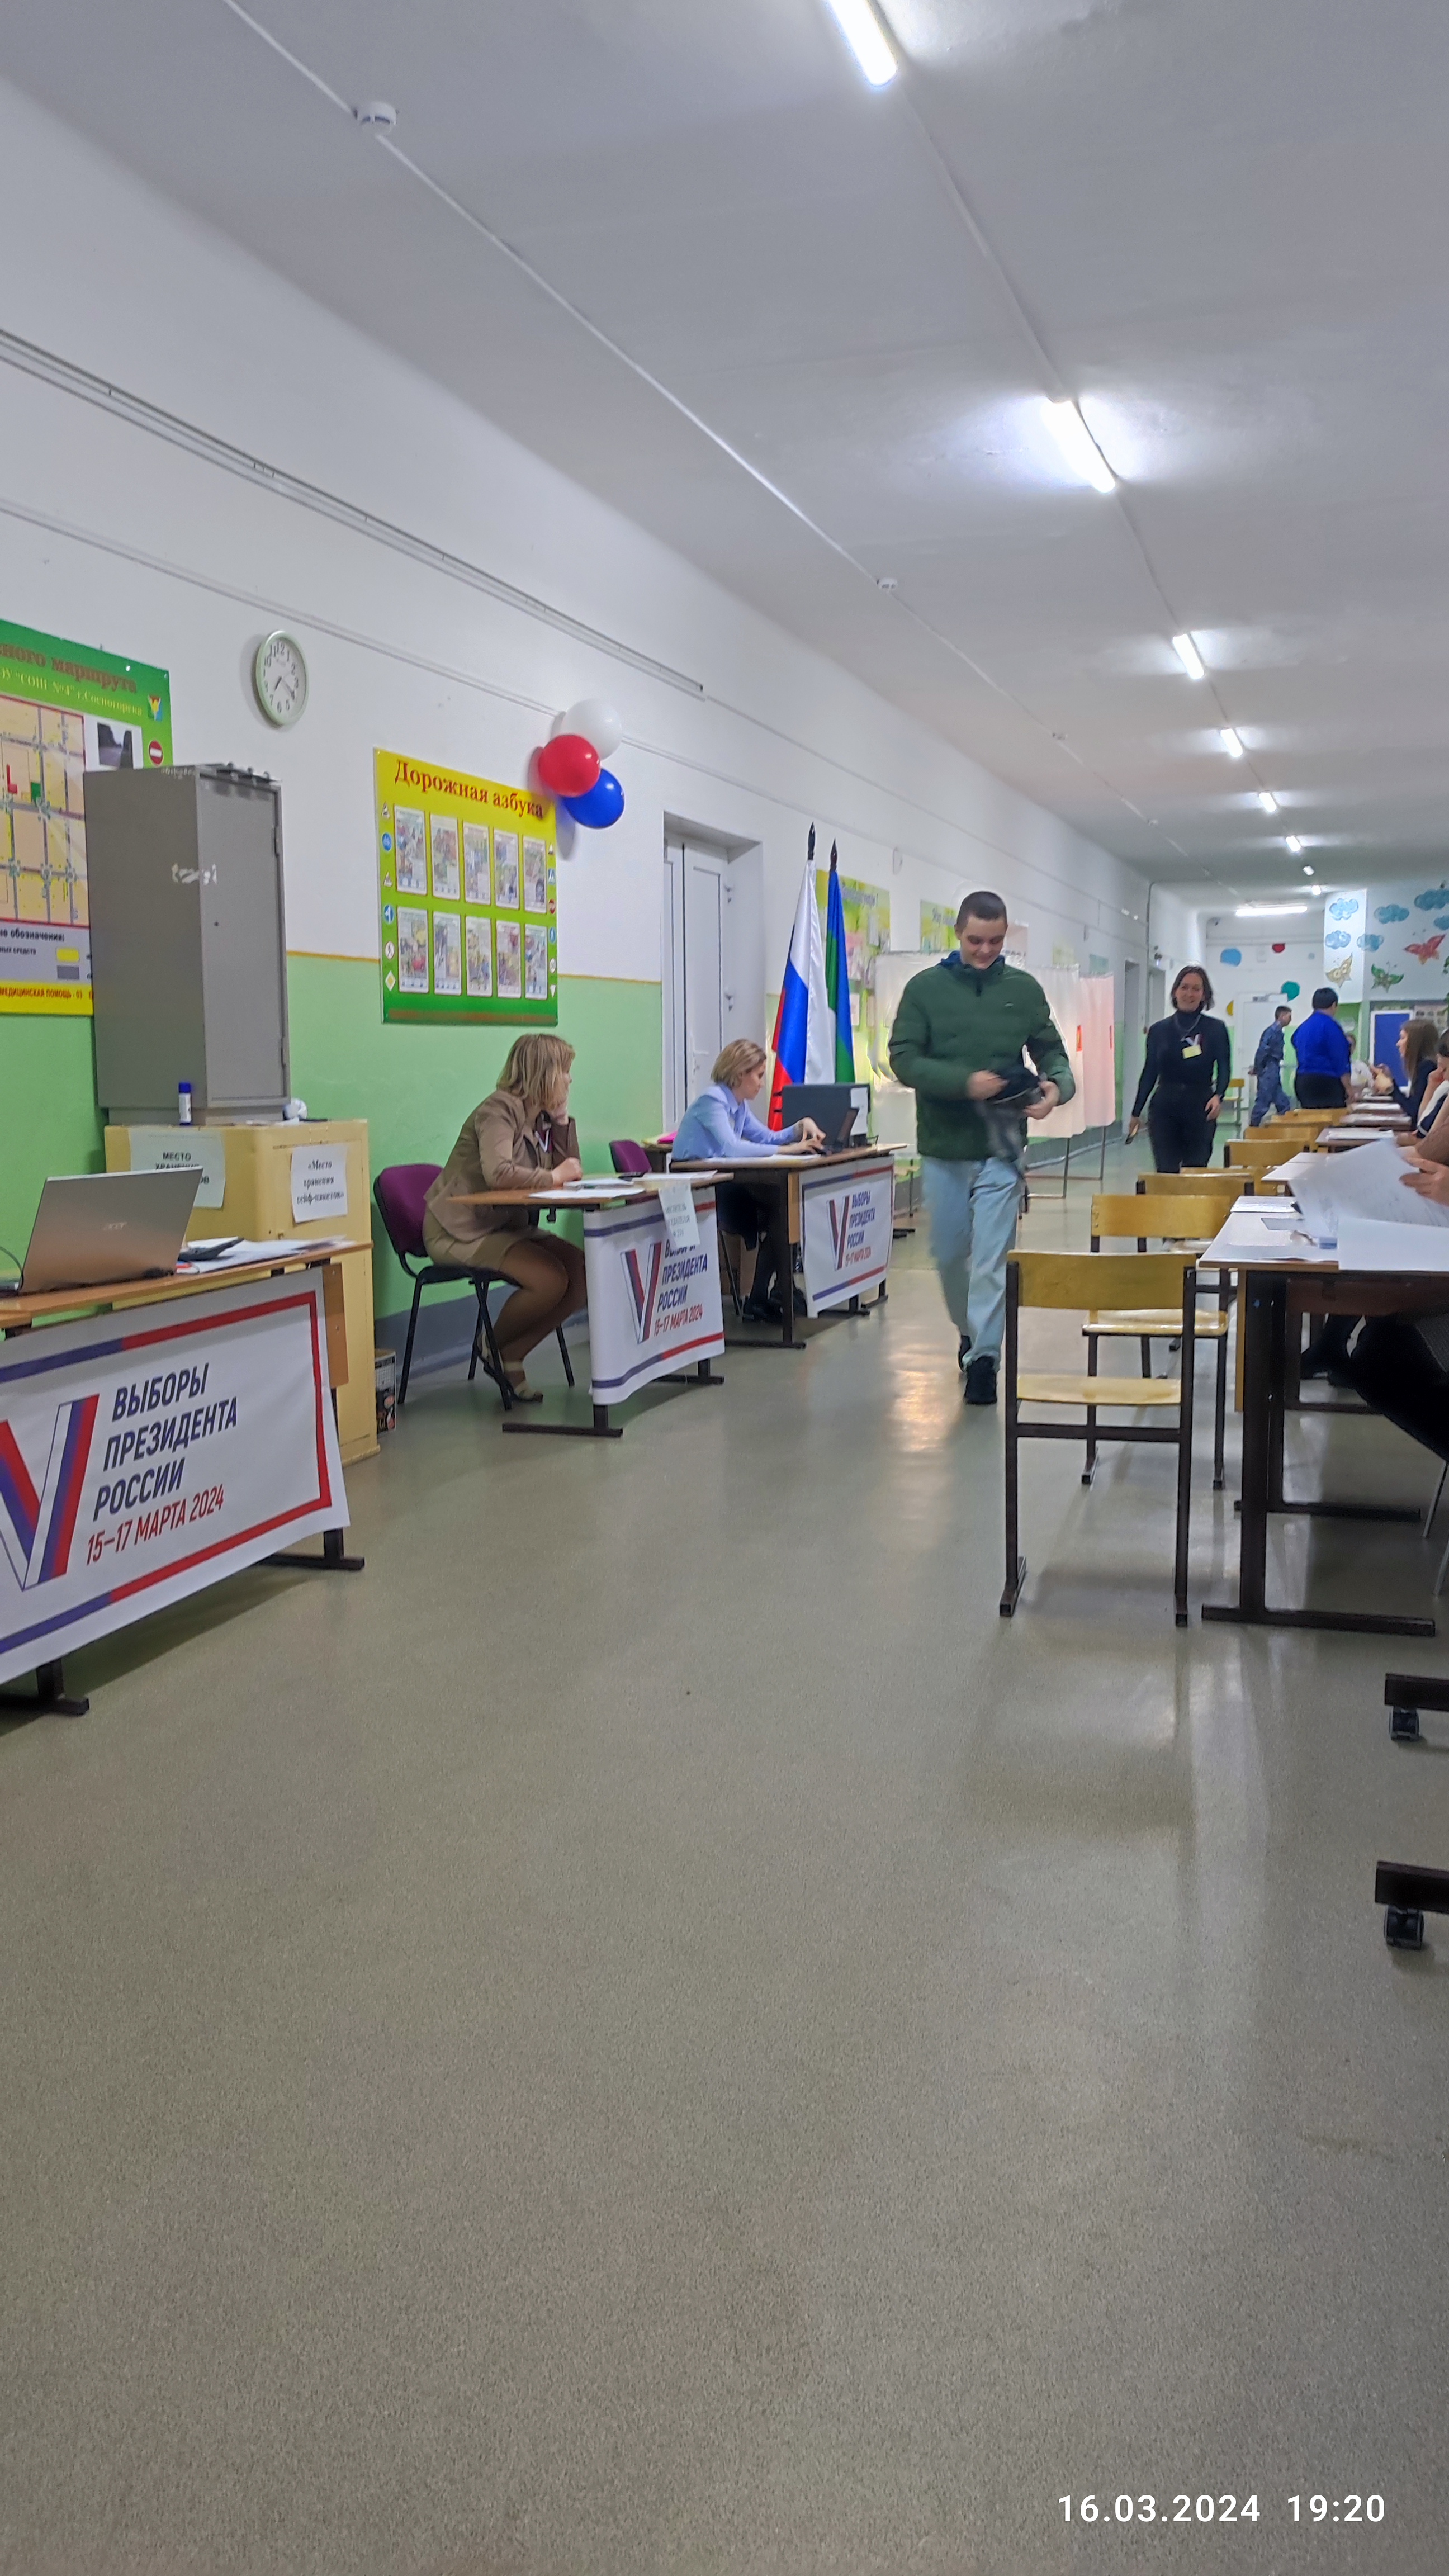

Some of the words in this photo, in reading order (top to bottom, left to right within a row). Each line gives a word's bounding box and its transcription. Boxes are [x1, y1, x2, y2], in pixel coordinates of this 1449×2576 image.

[277, 641, 285, 656] 12
[52, 657, 136, 693] маршрута
[394, 759, 488, 803] Дорожная
[493, 792, 544, 820] азбука
[163, 1152, 192, 1161] МЕСТО
[852, 1190, 871, 1209] ВЫБОРЫ
[849, 1207, 875, 1228] ПРЕЗИДЕНТА
[847, 1230, 865, 1249] РОССИИ
[662, 1253, 708, 1286] ПРЕЗИДЕНТА
[657, 1284, 688, 1314] РОССИИ
[670, 1310, 688, 1333] МАРТА
[688, 1304, 704, 1323] 2024
[112, 1363, 209, 1422] ВЫБОРЫ
[103, 1396, 237, 1472] ПРЕЗИДЕНТА
[93, 1457, 186, 1522] РОССИИ
[134, 1499, 187, 1546] МАРТА
[189, 1484, 225, 1523] 2024
